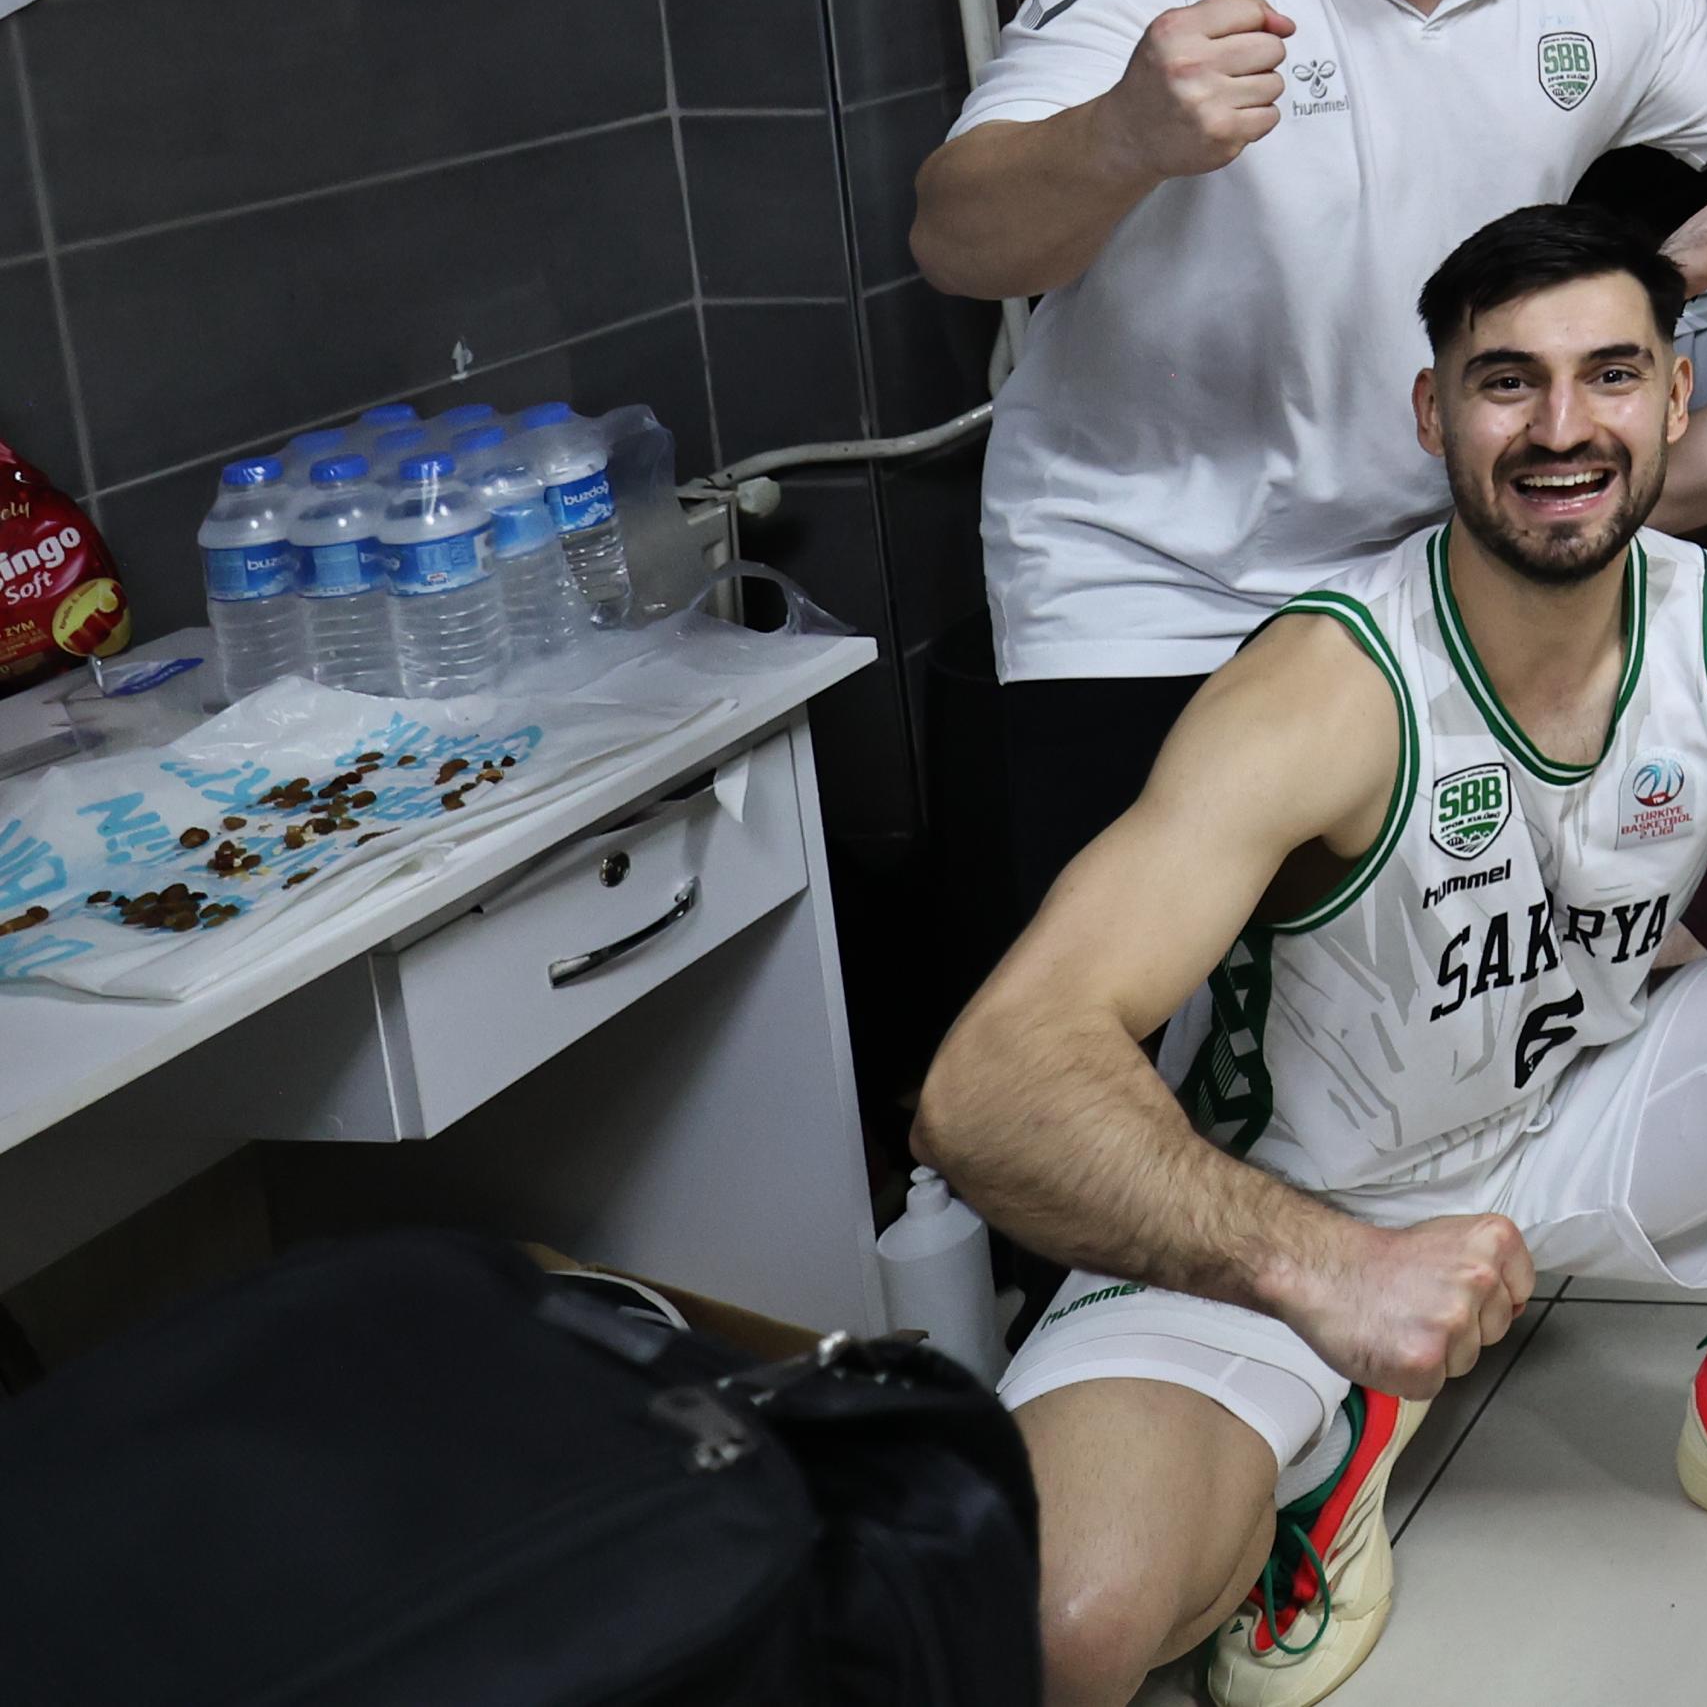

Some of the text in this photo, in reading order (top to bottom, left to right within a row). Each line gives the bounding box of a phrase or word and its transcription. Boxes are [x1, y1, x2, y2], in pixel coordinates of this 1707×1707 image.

[1543, 43, 1591, 74] SBB
[1292, 94, 1350, 117] hummel
[0, 502, 31, 520] ely
[0, 527, 82, 587] ingo
[5, 569, 54, 606] Soft
[1438, 775, 1503, 823] SBB
[1621, 813, 1694, 835] BASKETBOL
[1422, 858, 1512, 909] hummel
[1514, 988, 1585, 1090] 6
